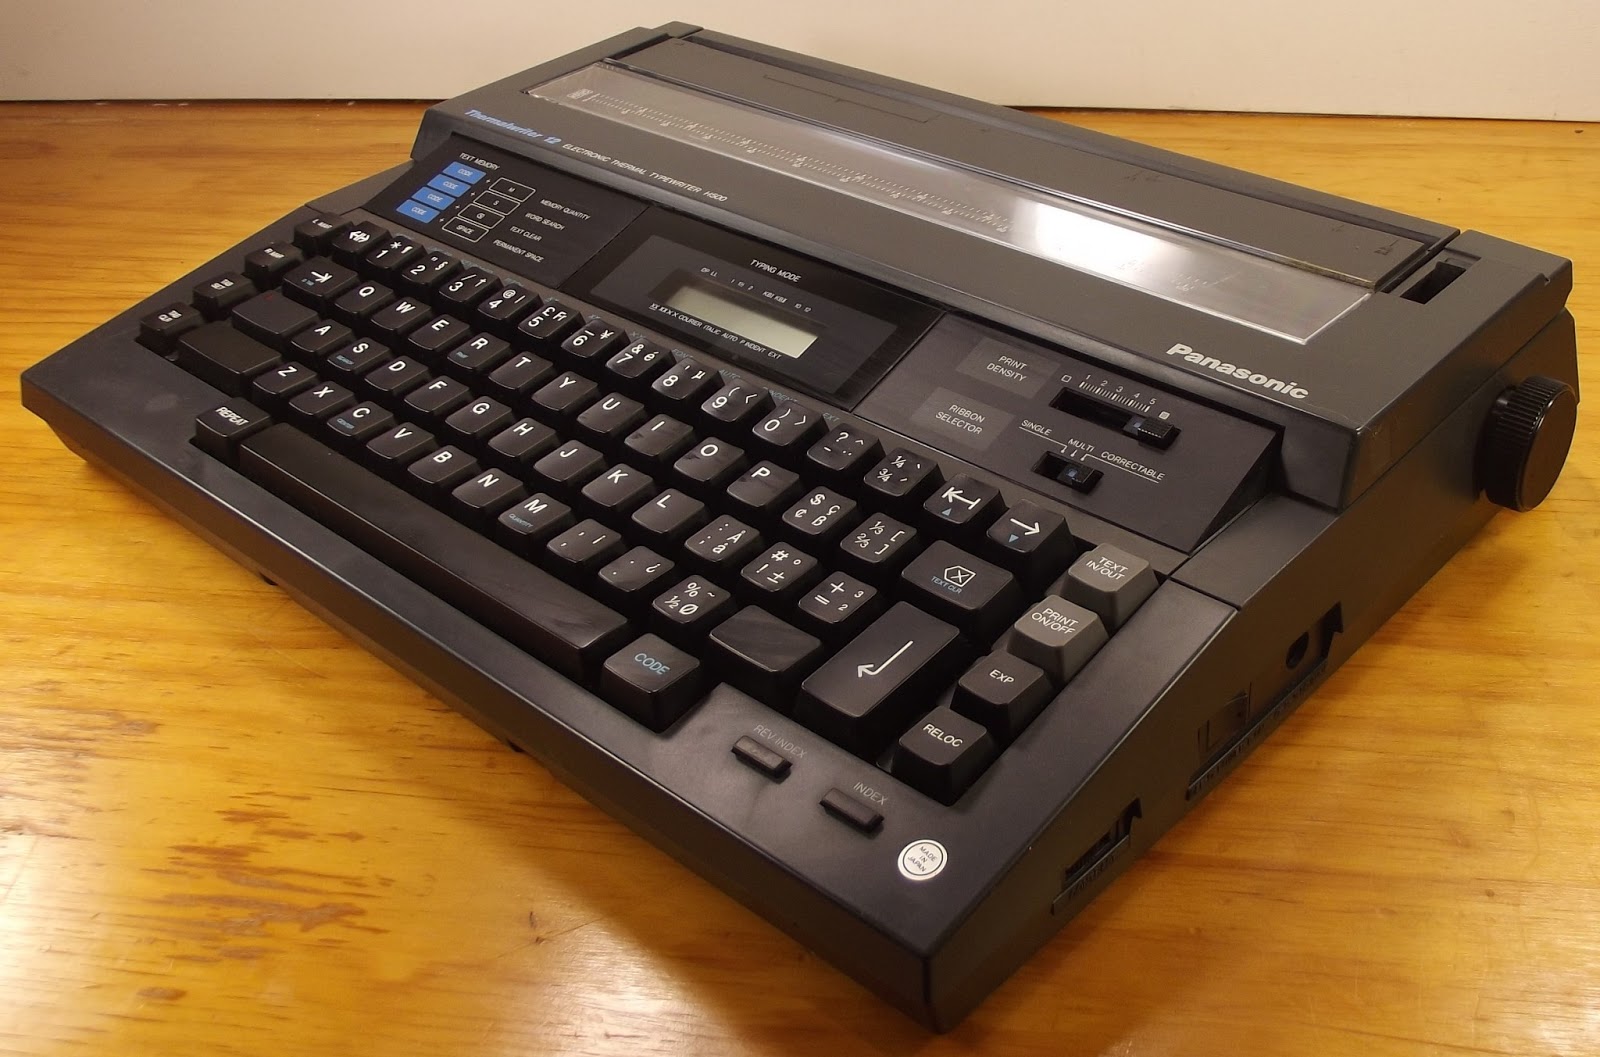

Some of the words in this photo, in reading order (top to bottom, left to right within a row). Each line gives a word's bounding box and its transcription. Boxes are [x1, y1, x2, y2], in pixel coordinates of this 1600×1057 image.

[465, 109, 543, 138] Thermalwriter
[544, 135, 562, 145] 12
[459, 152, 474, 162] TEXT
[475, 157, 500, 171] MEMORY
[562, 143, 612, 162] ELECTRONIC
[611, 159, 647, 176] THERMAL
[649, 171, 702, 193] TYPEWRITER
[457, 168, 474, 177] CODE
[442, 181, 458, 190] CODE
[427, 193, 443, 203] CODE
[540, 199, 564, 212] MEMORY
[563, 206, 591, 221] QUANTITY
[411, 206, 428, 216] CODE
[456, 224, 474, 235] SPACE
[525, 212, 543, 224] WORD
[542, 218, 566, 231] SEARCH
[509, 226, 524, 235] TEXT
[521, 230, 543, 242] CLEAR
[376, 249, 389, 259] 1
[493, 239, 527, 255] PERMANENT
[524, 250, 545, 263] SPACE
[410, 264, 426, 275] 2
[750, 259, 777, 274] TYPING
[777, 269, 802, 283] MODE
[358, 286, 375, 298] Q
[448, 281, 465, 292] 3
[502, 289, 517, 299] @
[395, 301, 416, 314] W
[489, 298, 503, 309] 4
[431, 318, 450, 331] E
[528, 316, 544, 328] 5
[314, 324, 332, 336] A
[678, 313, 703, 328] COURIER
[703, 324, 722, 336] ITALIC
[721, 331, 739, 342] AUTO
[744, 340, 767, 354] INDENT
[767, 350, 782, 360] EXT
[470, 336, 489, 350] R
[572, 335, 588, 346] 6
[352, 342, 370, 354] S
[515, 356, 532, 369] T
[616, 352, 634, 364] 7
[998, 355, 1028, 371] PRINT
[277, 365, 298, 378] Z
[388, 360, 407, 372] D
[986, 363, 1027, 382] DENSITY
[1166, 343, 1309, 399] Panasonic
[428, 379, 449, 391] F
[559, 376, 577, 389] Y
[662, 374, 679, 387] 8
[312, 385, 335, 399] X
[1100, 379, 1109, 387] 2
[1115, 385, 1124, 393] 3
[1133, 392, 1141, 400] 4
[1149, 397, 1156, 405] 5
[472, 401, 491, 415] G
[602, 397, 621, 411] U
[711, 396, 729, 409] 9
[214, 405, 251, 427] REPEAT
[352, 406, 371, 419] C
[823, 412, 840, 423] EXT
[948, 404, 986, 423] RIBBON
[512, 422, 535, 437] H
[650, 420, 666, 432] I
[935, 411, 983, 435] SELECTOR
[1021, 419, 1053, 436] SINGLE
[393, 427, 414, 440] V
[700, 443, 719, 457] O
[1067, 438, 1095, 452] MULTI
[432, 450, 453, 464] B
[559, 447, 579, 459] J
[751, 466, 771, 479] P
[1100, 450, 1165, 481] CORRECTABLE
[477, 473, 500, 488] N
[606, 468, 629, 484] K
[523, 498, 549, 514] M
[656, 493, 672, 509] L
[508, 512, 535, 529] QUANTITY
[1086, 560, 1126, 582] IN/OUT
[1098, 556, 1129, 574] TEXT
[931, 575, 951, 588] TEXT
[946, 582, 963, 595] CLR
[1031, 612, 1076, 636] ON/OFF
[1043, 607, 1079, 628] PRINT
[634, 652, 671, 676] CODE
[989, 669, 1015, 685] EXP
[753, 723, 776, 741] REV
[774, 736, 808, 759] INDEX
[923, 723, 963, 749] RELOC
[853, 780, 889, 807] INDEX
[919, 845, 938, 863] MADE
[919, 855, 928, 863] IN
[907, 855, 927, 873] JAPAN
